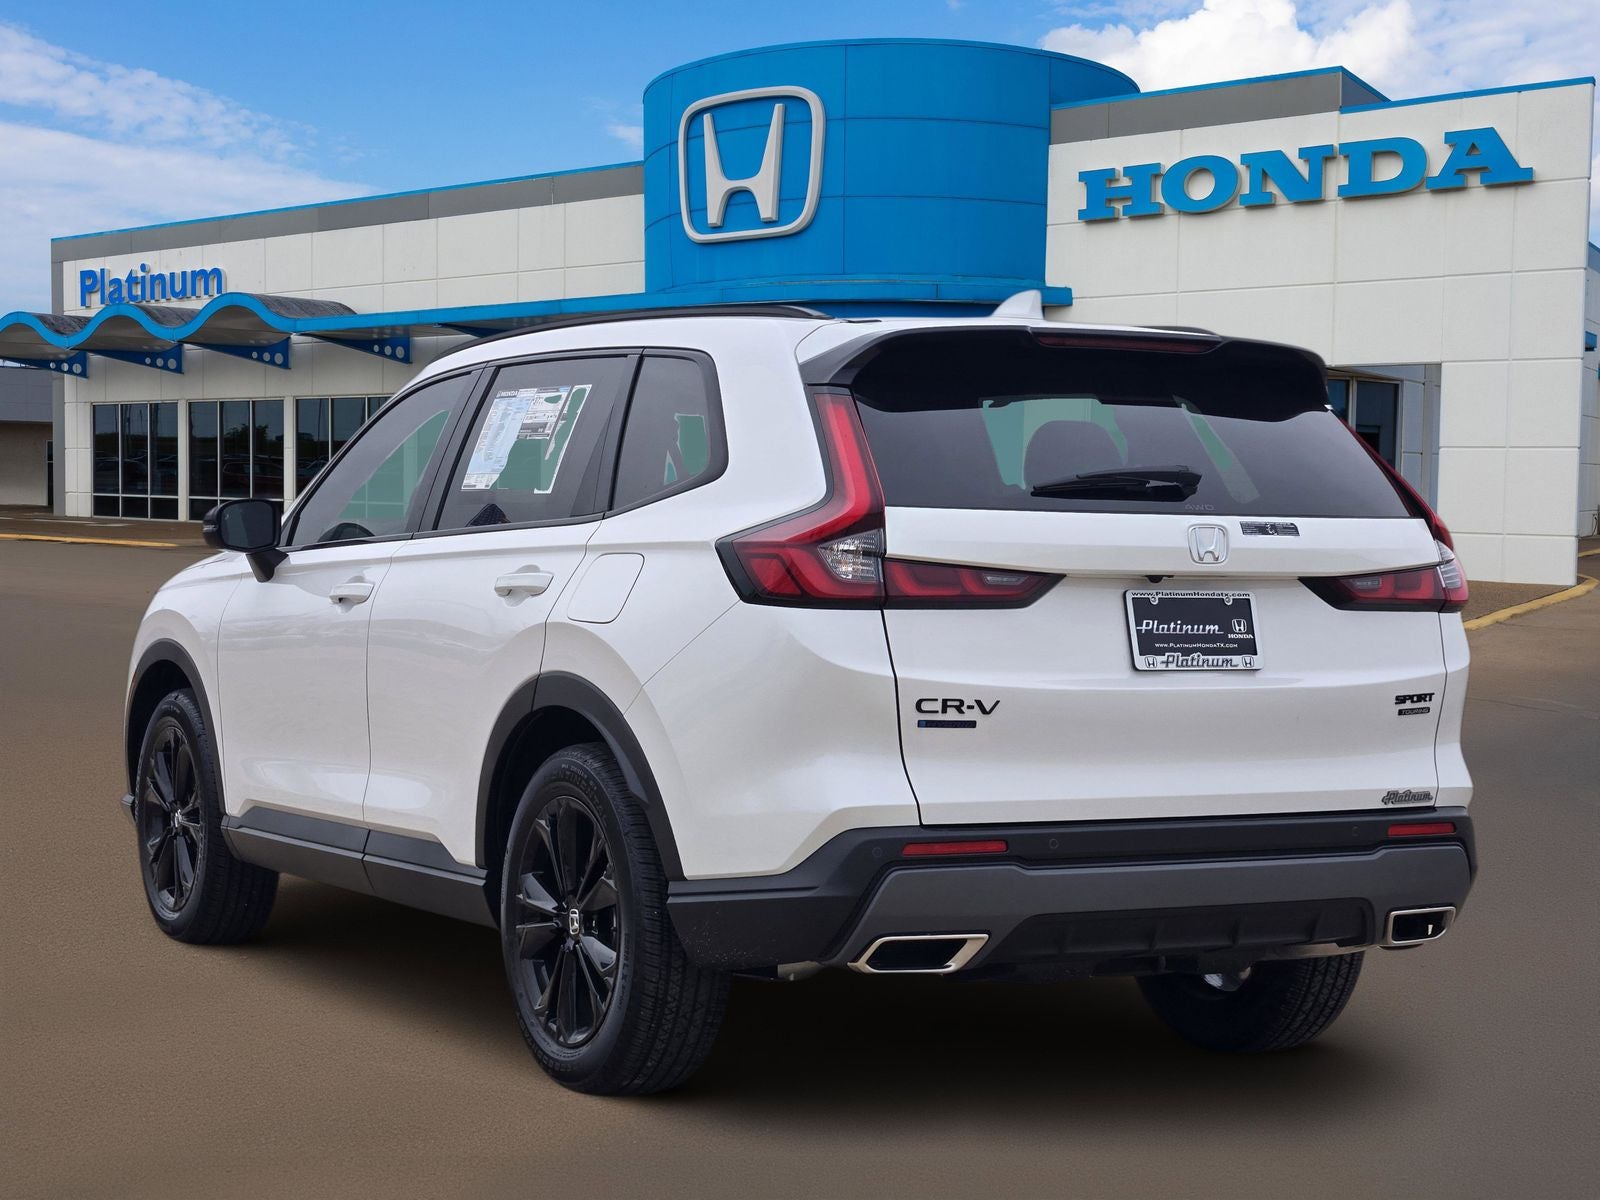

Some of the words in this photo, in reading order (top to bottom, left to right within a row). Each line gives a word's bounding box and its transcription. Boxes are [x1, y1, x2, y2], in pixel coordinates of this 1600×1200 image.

[1077, 126, 1534, 222] HONDA
[80, 262, 225, 307] Platinum
[1137, 619, 1225, 635] Platinum
[1160, 652, 1240, 669] Platinum
[915, 698, 1001, 715] CR-V
[1394, 692, 1435, 705] SPORT
[1381, 789, 1433, 805] Platinum
